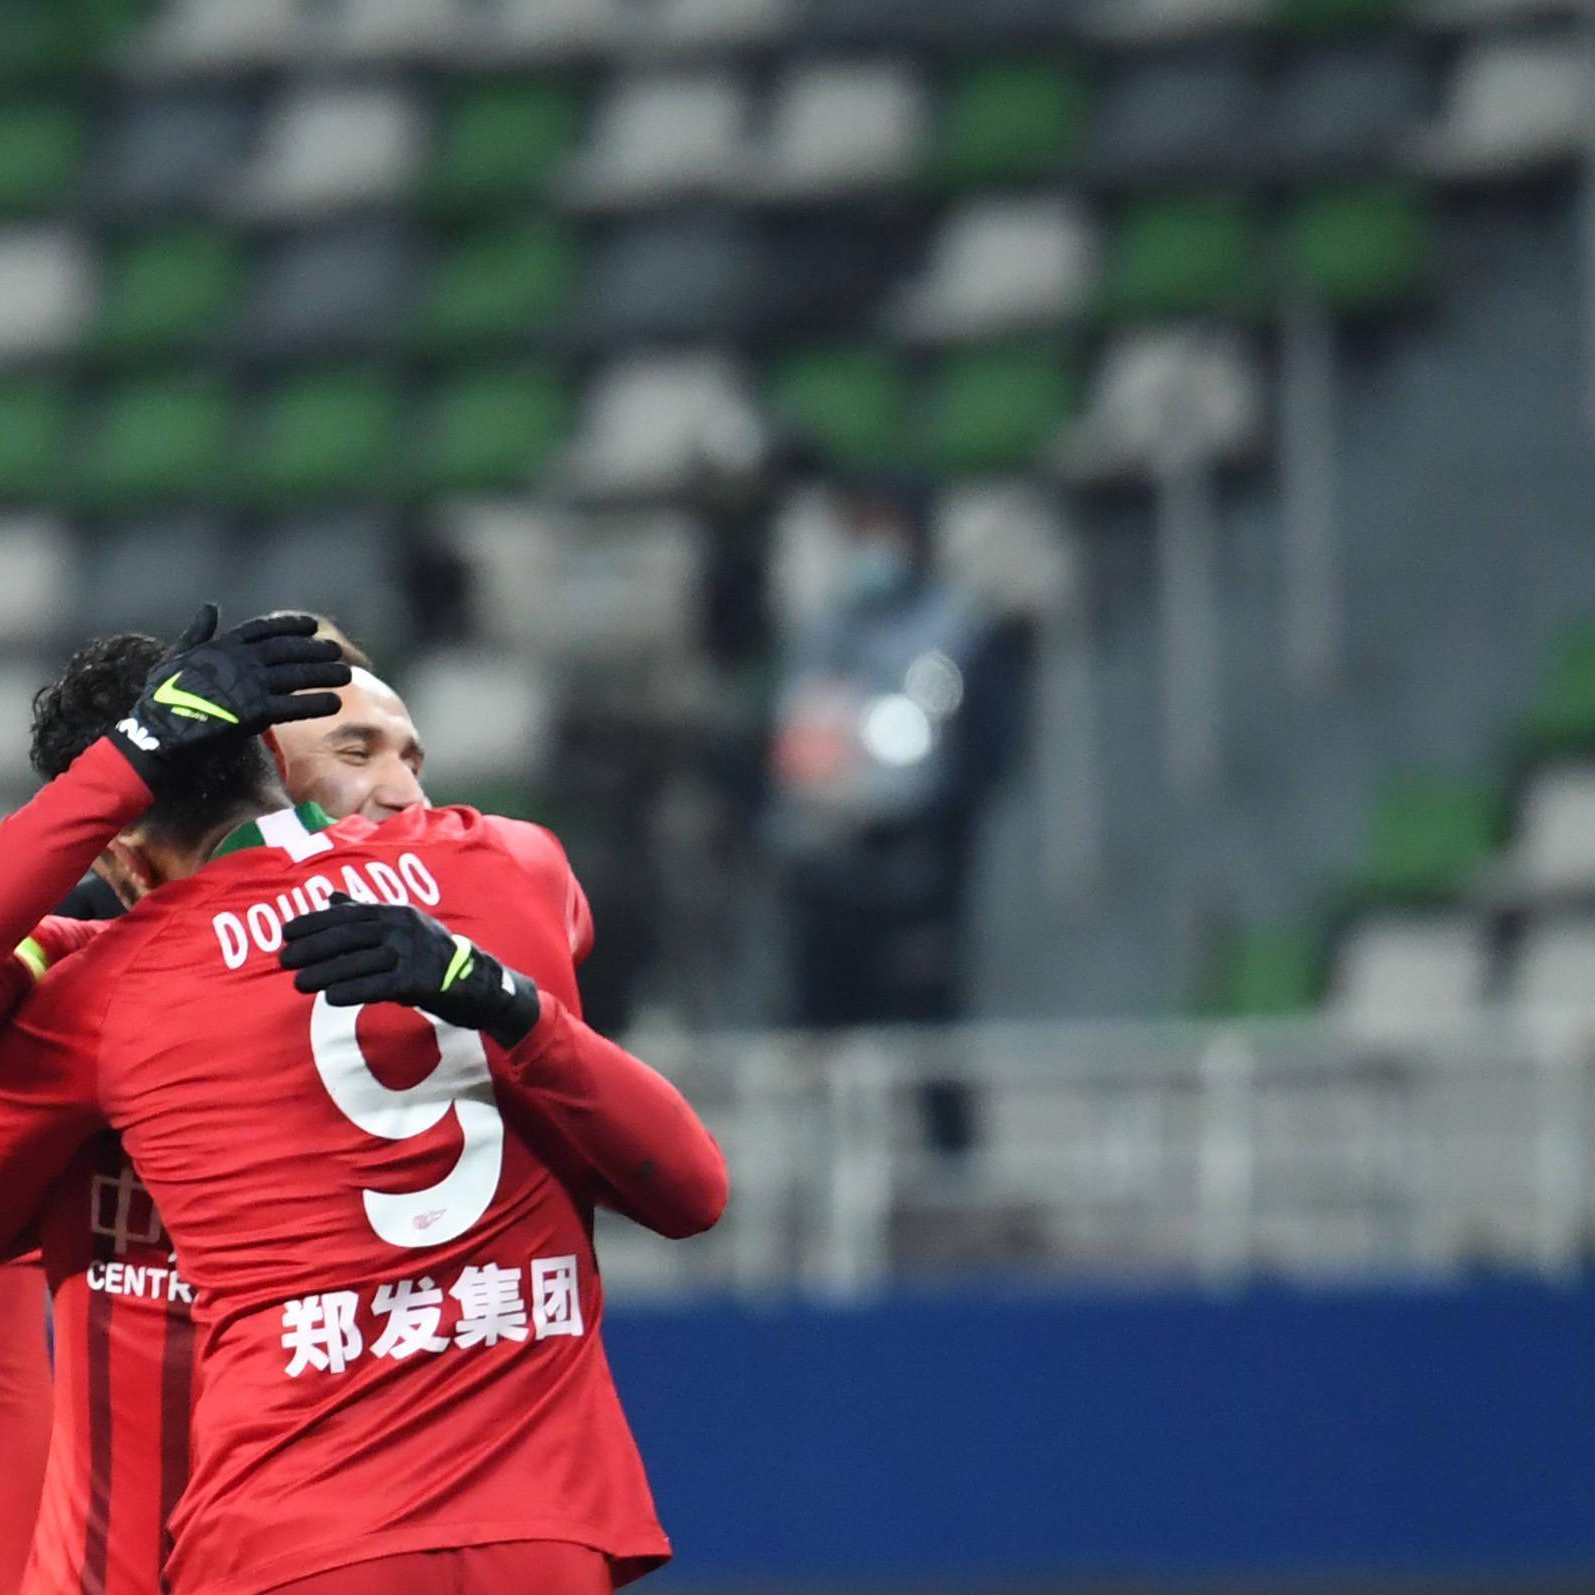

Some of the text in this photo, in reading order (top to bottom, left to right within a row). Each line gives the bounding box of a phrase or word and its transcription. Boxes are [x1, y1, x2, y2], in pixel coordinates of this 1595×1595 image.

[309, 989, 504, 1248] 9
[281, 1254, 584, 1377] 郑发集团
